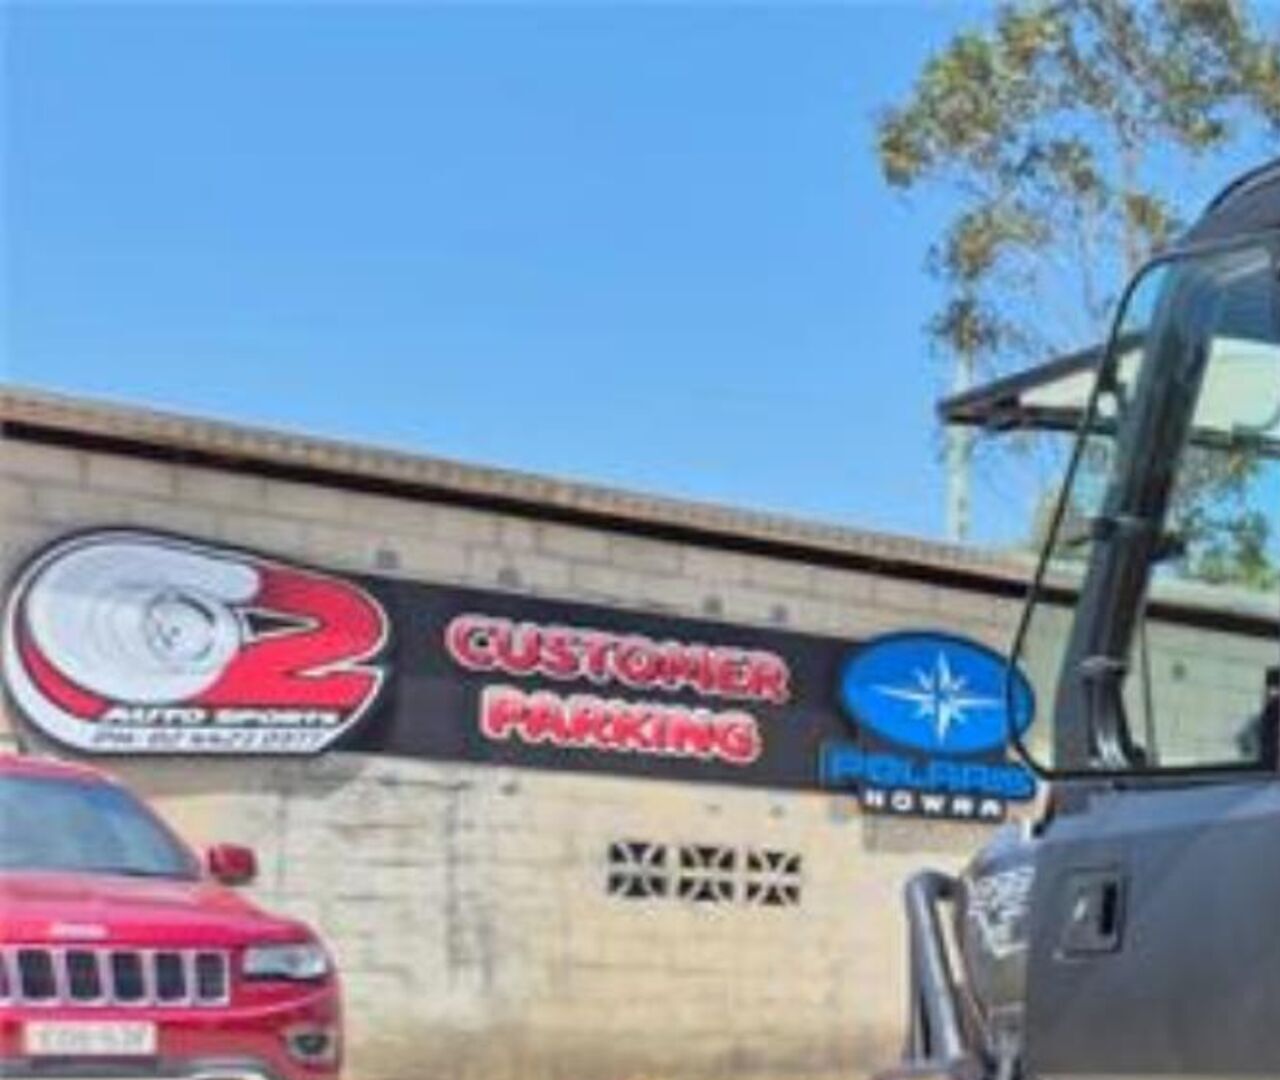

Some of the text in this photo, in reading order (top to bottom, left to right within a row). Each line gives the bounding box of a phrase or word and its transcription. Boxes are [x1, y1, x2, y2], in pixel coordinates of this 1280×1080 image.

[446, 616, 790, 703] CUSTOMER
[103, 706, 205, 727] AUTO
[482, 685, 762, 763] PARKING
[864, 788, 1001, 818] NOWRA
